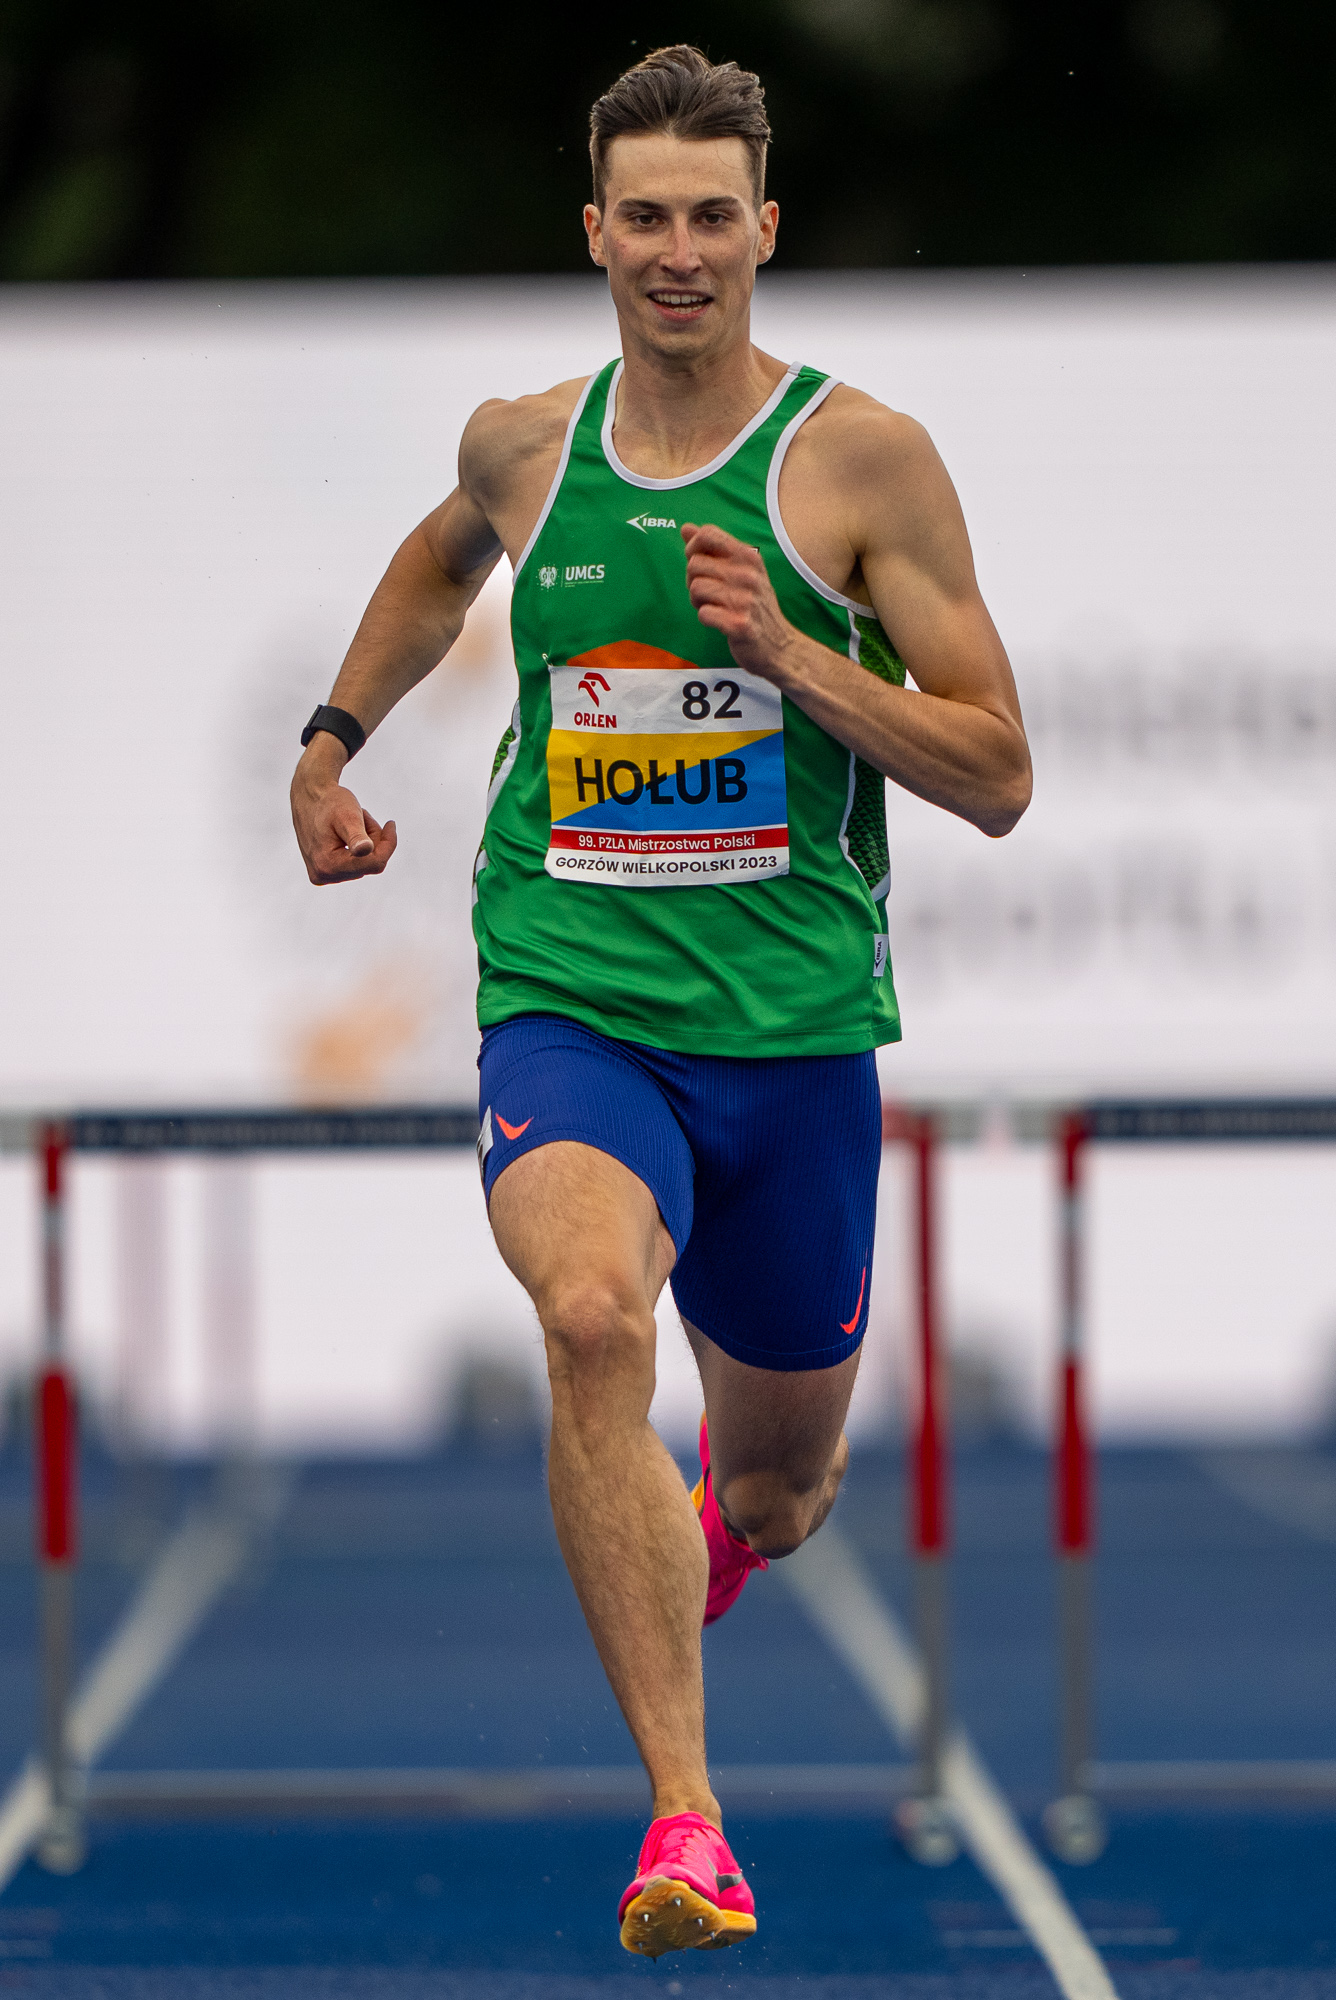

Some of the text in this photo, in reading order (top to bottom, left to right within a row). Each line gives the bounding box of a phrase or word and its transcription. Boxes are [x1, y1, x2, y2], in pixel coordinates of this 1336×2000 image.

[642, 517, 677, 528] IBRA
[565, 564, 605, 581] UMCS
[682, 680, 743, 721] 82
[574, 712, 617, 728] ORLEN
[575, 757, 748, 805] HOŁUB
[578, 834, 756, 852] 99. PZLA Mistrzostwa Polski
[555, 855, 778, 874] GORZÓW WIELKOPOLSKI 2023
